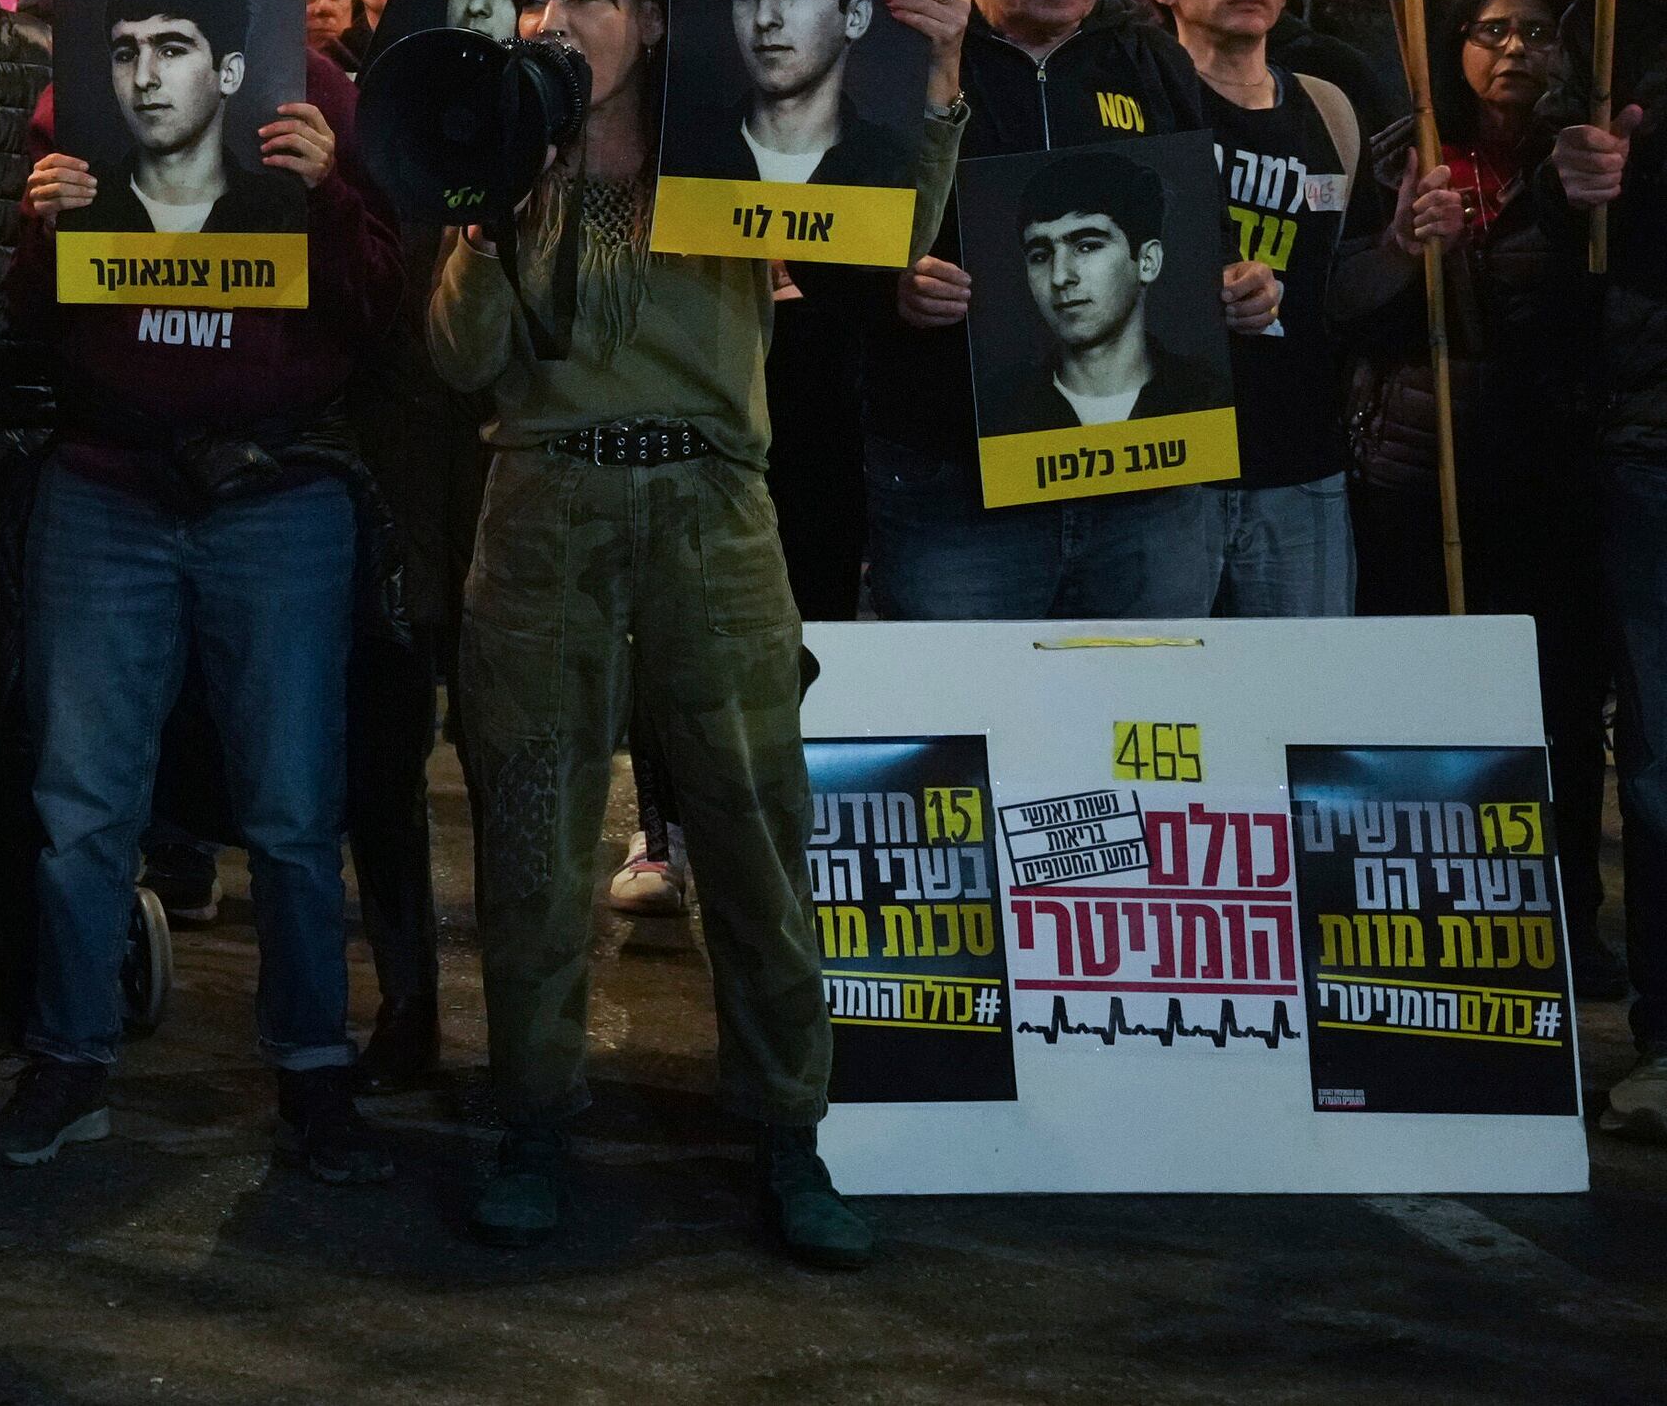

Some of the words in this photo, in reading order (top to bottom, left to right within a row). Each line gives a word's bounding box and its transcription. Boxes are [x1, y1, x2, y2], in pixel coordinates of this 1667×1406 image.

[1230, 149, 1308, 214] למה
[732, 203, 774, 239] לוי
[781, 209, 834, 243] אור
[90, 258, 211, 291] צנגאוקר
[221, 258, 276, 293] מתן
[138, 307, 234, 349] NOW!
[1035, 446, 1115, 489] כלפון
[1123, 437, 1187, 473] שגב
[1116, 722, 1201, 783] 465
[927, 788, 973, 844] 15
[1020, 801, 1070, 827] ואנשי
[1077, 793, 1119, 817] נשות
[1300, 800, 1478, 854] חודשים
[1483, 804, 1534, 855] 15
[1045, 822, 1107, 852] בריאות
[1101, 842, 1141, 868] למען
[1144, 802, 1291, 889] כולם
[874, 846, 992, 901] בשבי
[1022, 851, 1098, 883] החטופים
[1353, 857, 1420, 911] הם
[1431, 857, 1552, 912] בשבי
[880, 903, 995, 958] סכנת
[1010, 900, 1297, 982] הומניטרי
[1317, 913, 1426, 968] מוות
[1437, 915, 1556, 969] סכנת
